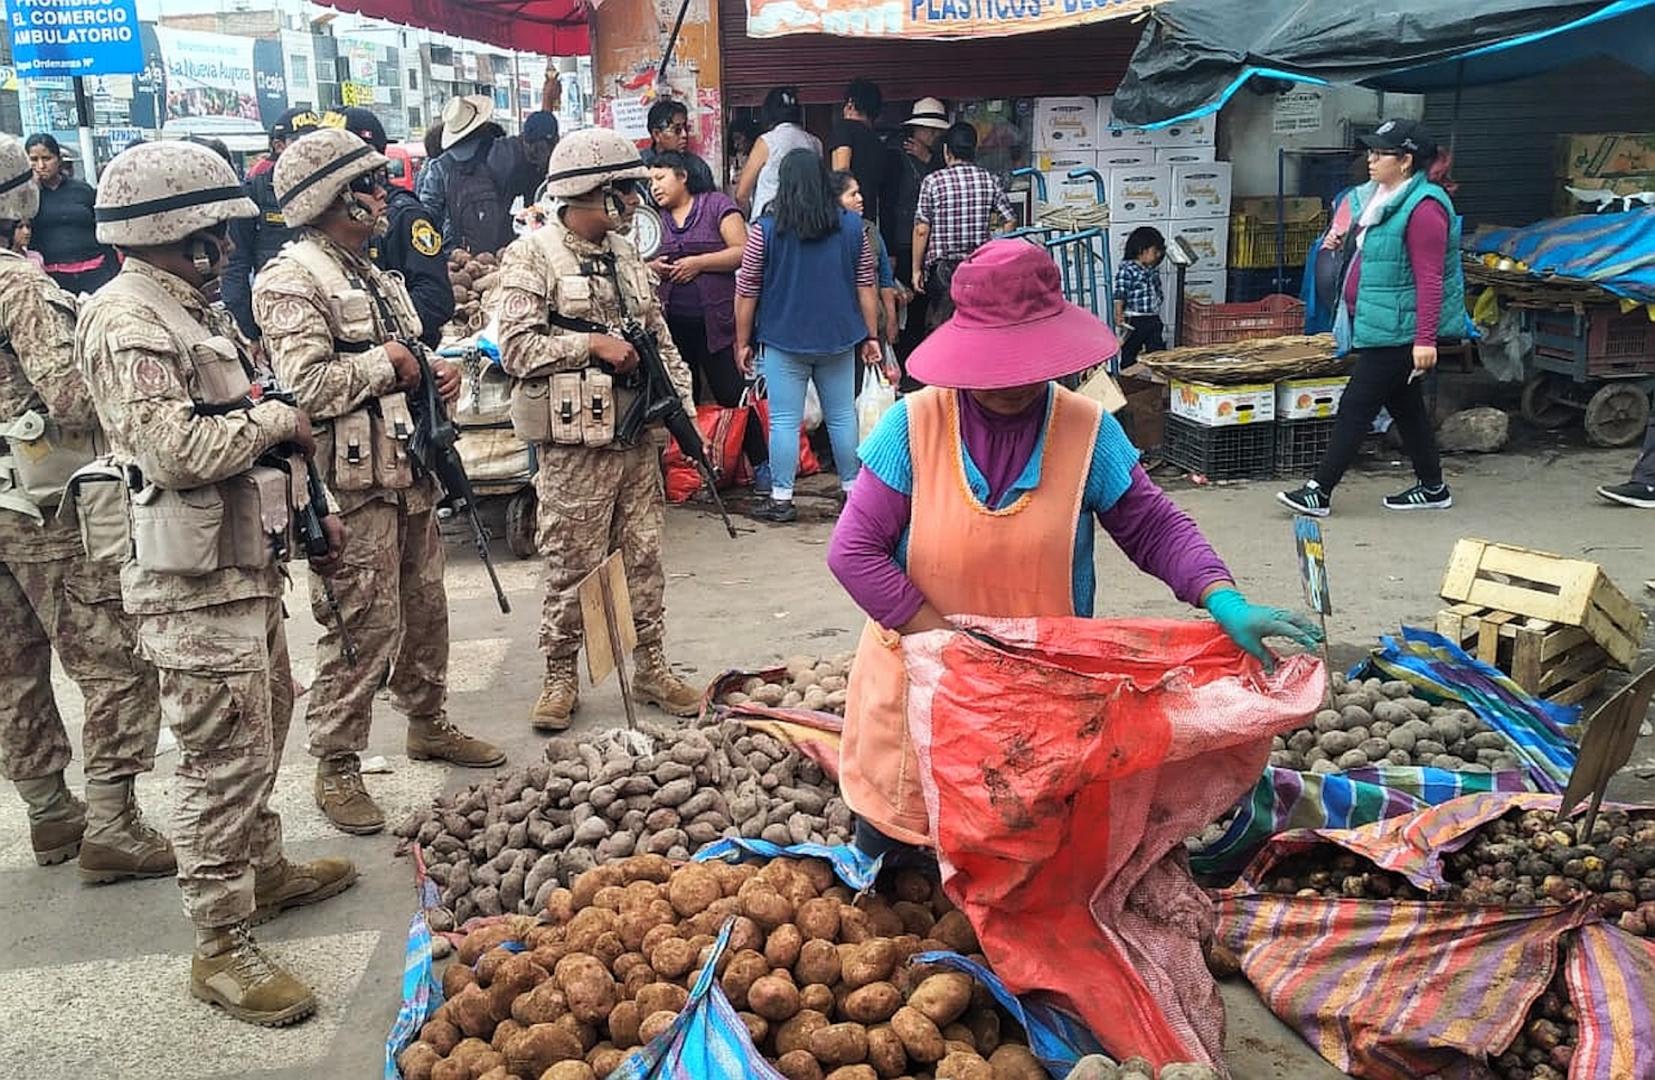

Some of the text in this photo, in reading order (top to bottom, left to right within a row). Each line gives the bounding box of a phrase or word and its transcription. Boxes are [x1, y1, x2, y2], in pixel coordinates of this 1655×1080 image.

[12, 8, 127, 26] EL COMERCIO
[15, 26, 132, 45] AMBULATORIO
